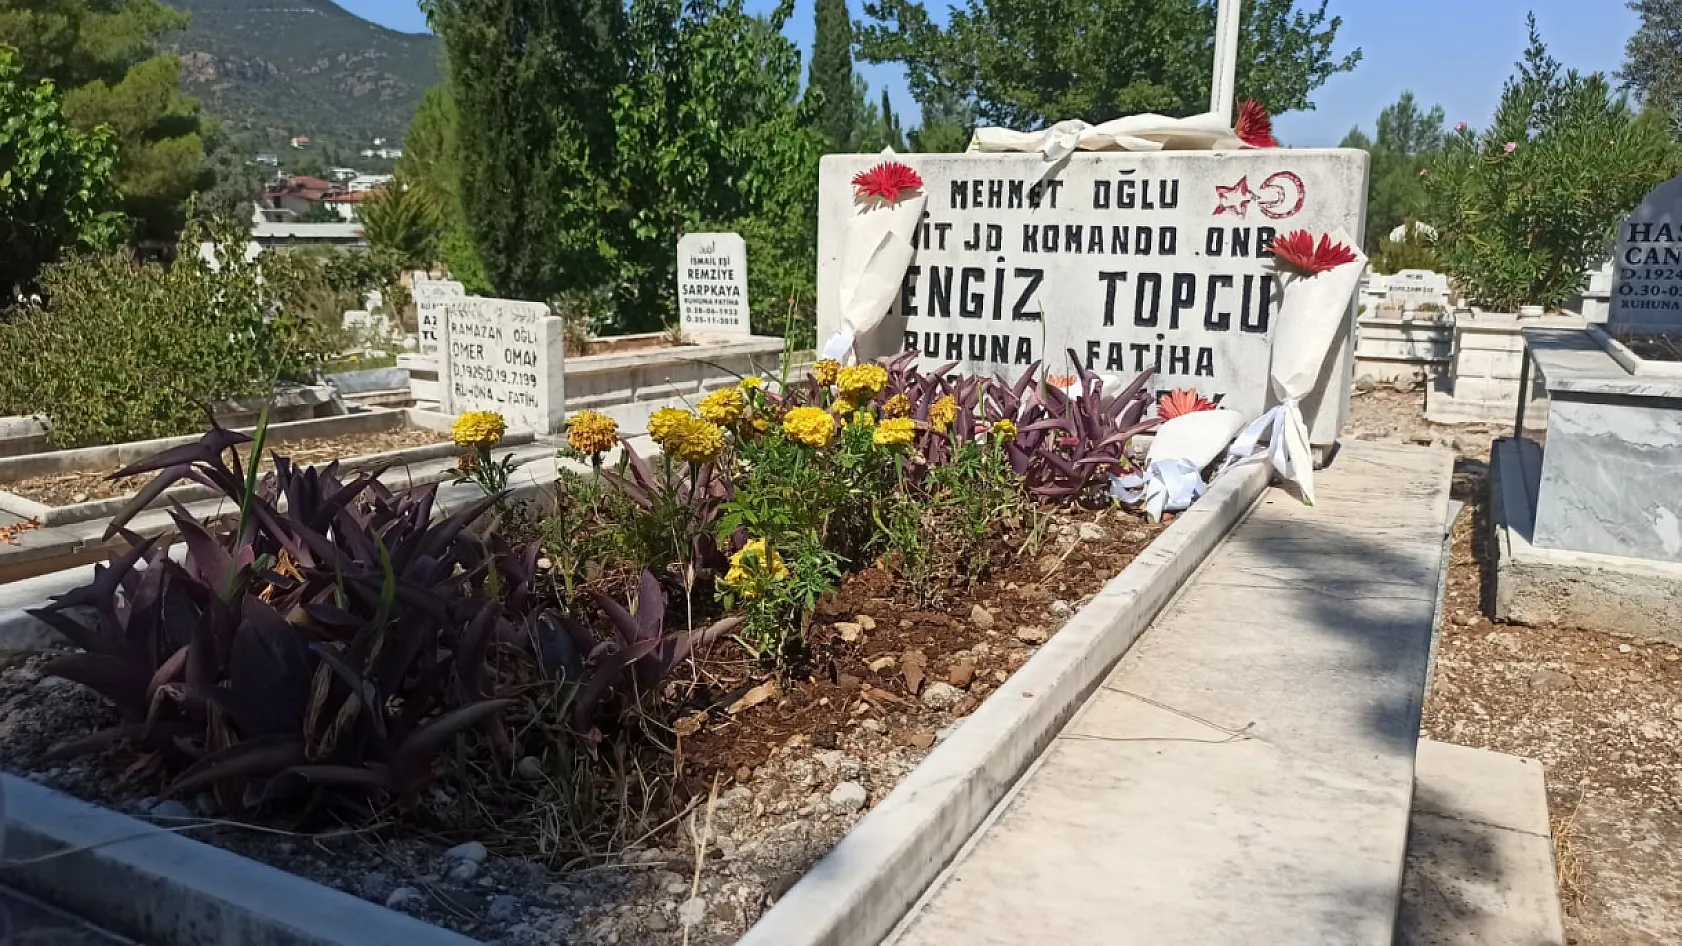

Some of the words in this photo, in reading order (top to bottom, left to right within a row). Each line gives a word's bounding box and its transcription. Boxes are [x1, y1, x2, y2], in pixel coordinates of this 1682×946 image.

[950, 179, 1064, 210] MEHMET
[1092, 168, 1180, 210] OĞLU
[963, 222, 1003, 252] JD
[1022, 223, 1177, 256] KOMANDO
[1626, 222, 1682, 242] HA
[687, 266, 735, 281] REMZİYE
[682, 284, 740, 297] SARPKAYA
[888, 255, 1045, 322] ENGİZ
[1620, 299, 1680, 310] RUHUNA
[451, 322, 503, 341] RAMAZAN
[513, 326, 537, 344] OĞL
[1084, 333, 1215, 378] FATİHA
